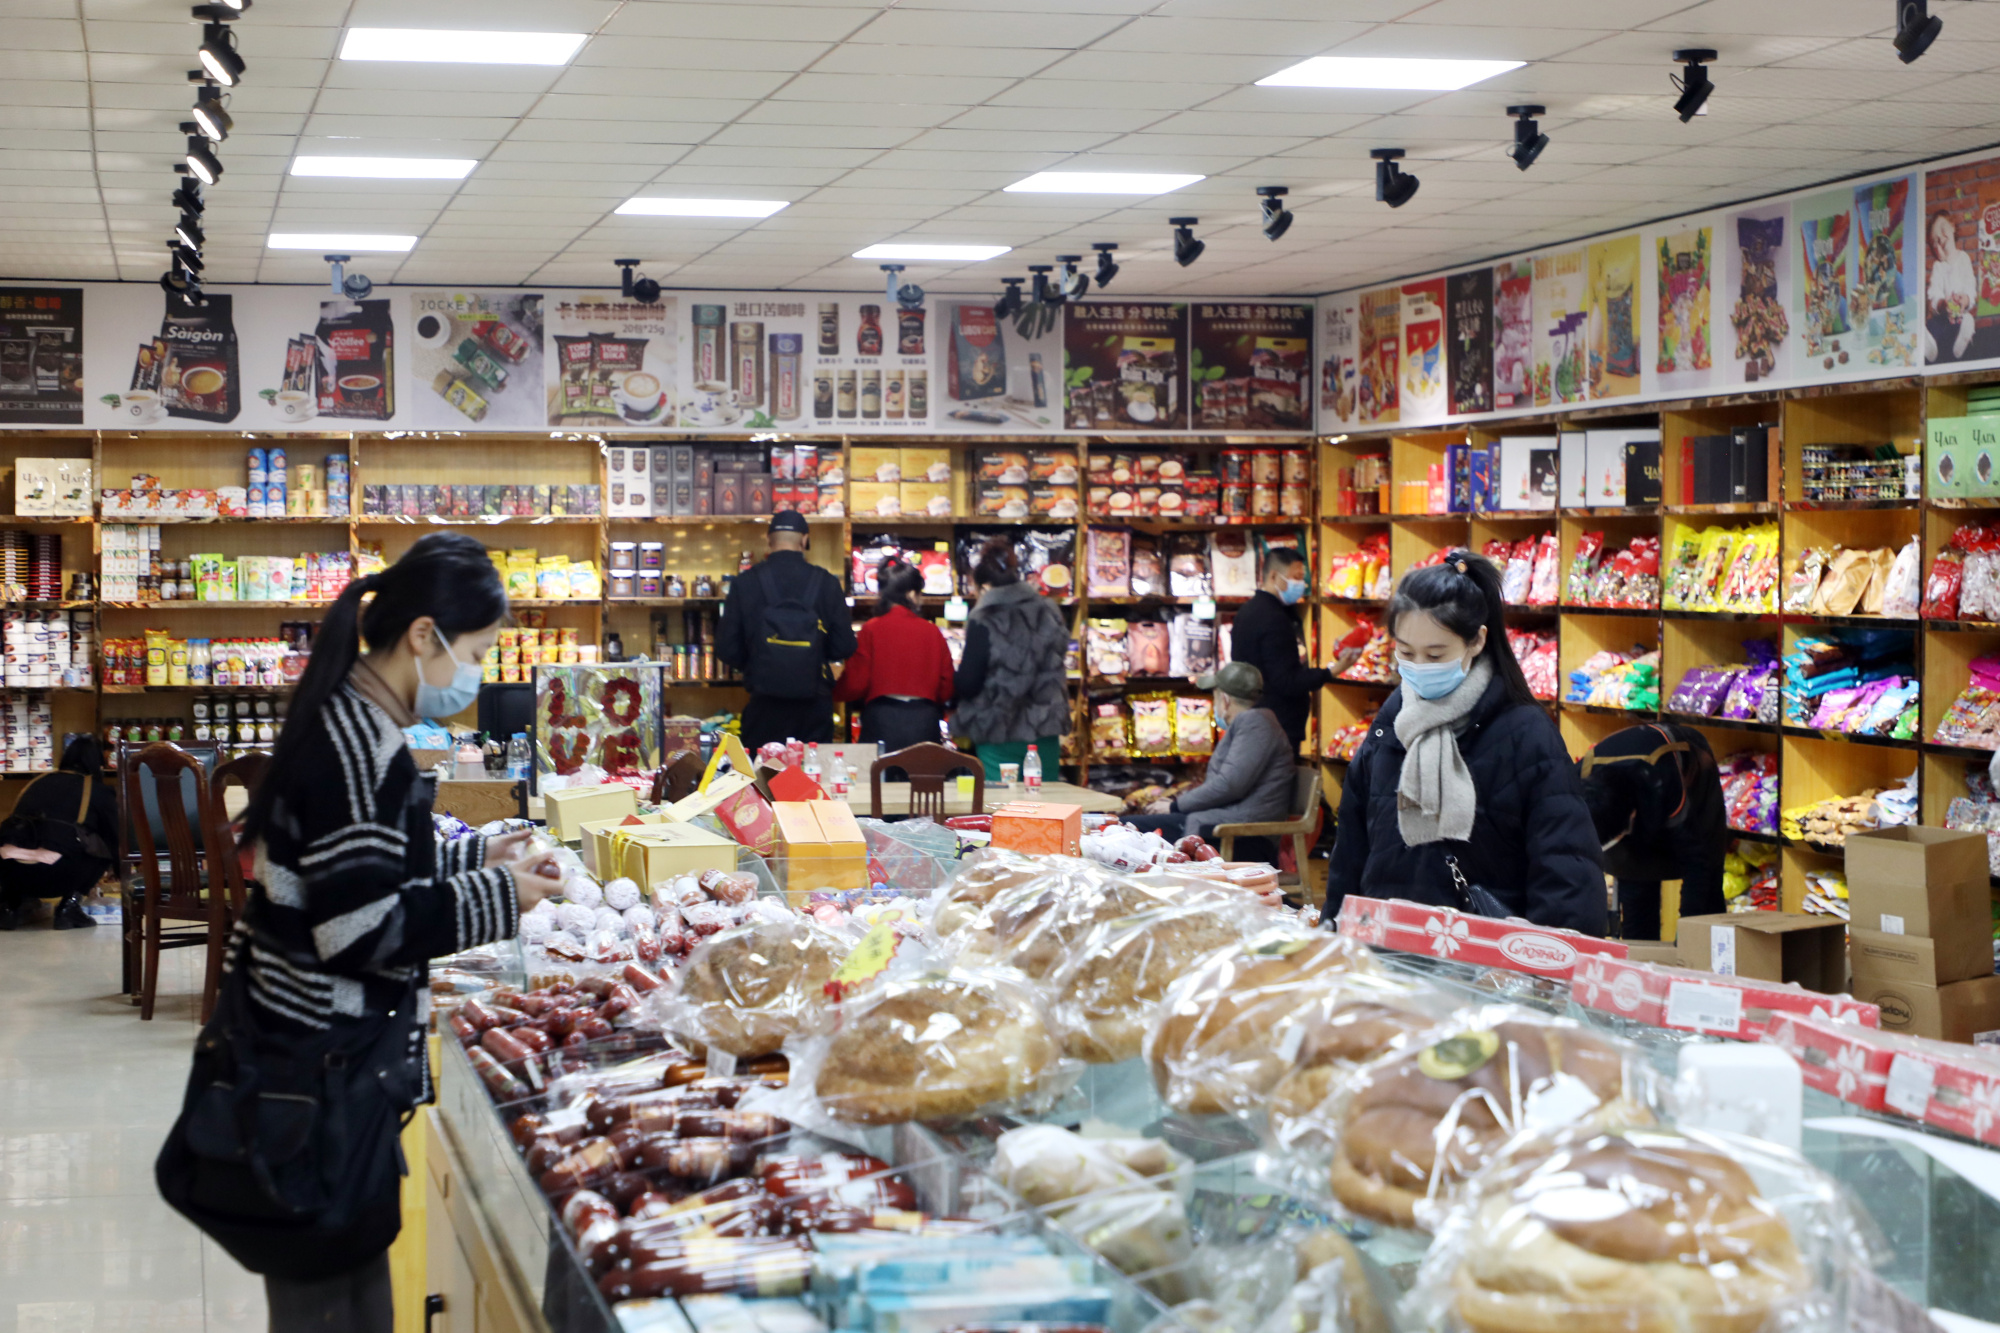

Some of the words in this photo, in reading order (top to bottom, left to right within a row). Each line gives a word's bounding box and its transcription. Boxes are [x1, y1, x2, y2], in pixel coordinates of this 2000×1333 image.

[733, 302, 805, 317] 进口苦咖啡
[1128, 306, 1179, 320] 分享快乐
[1255, 306, 1305, 319] 分享快乐
[600, 344, 627, 352] TORA
[603, 352, 625, 360] BIKA
